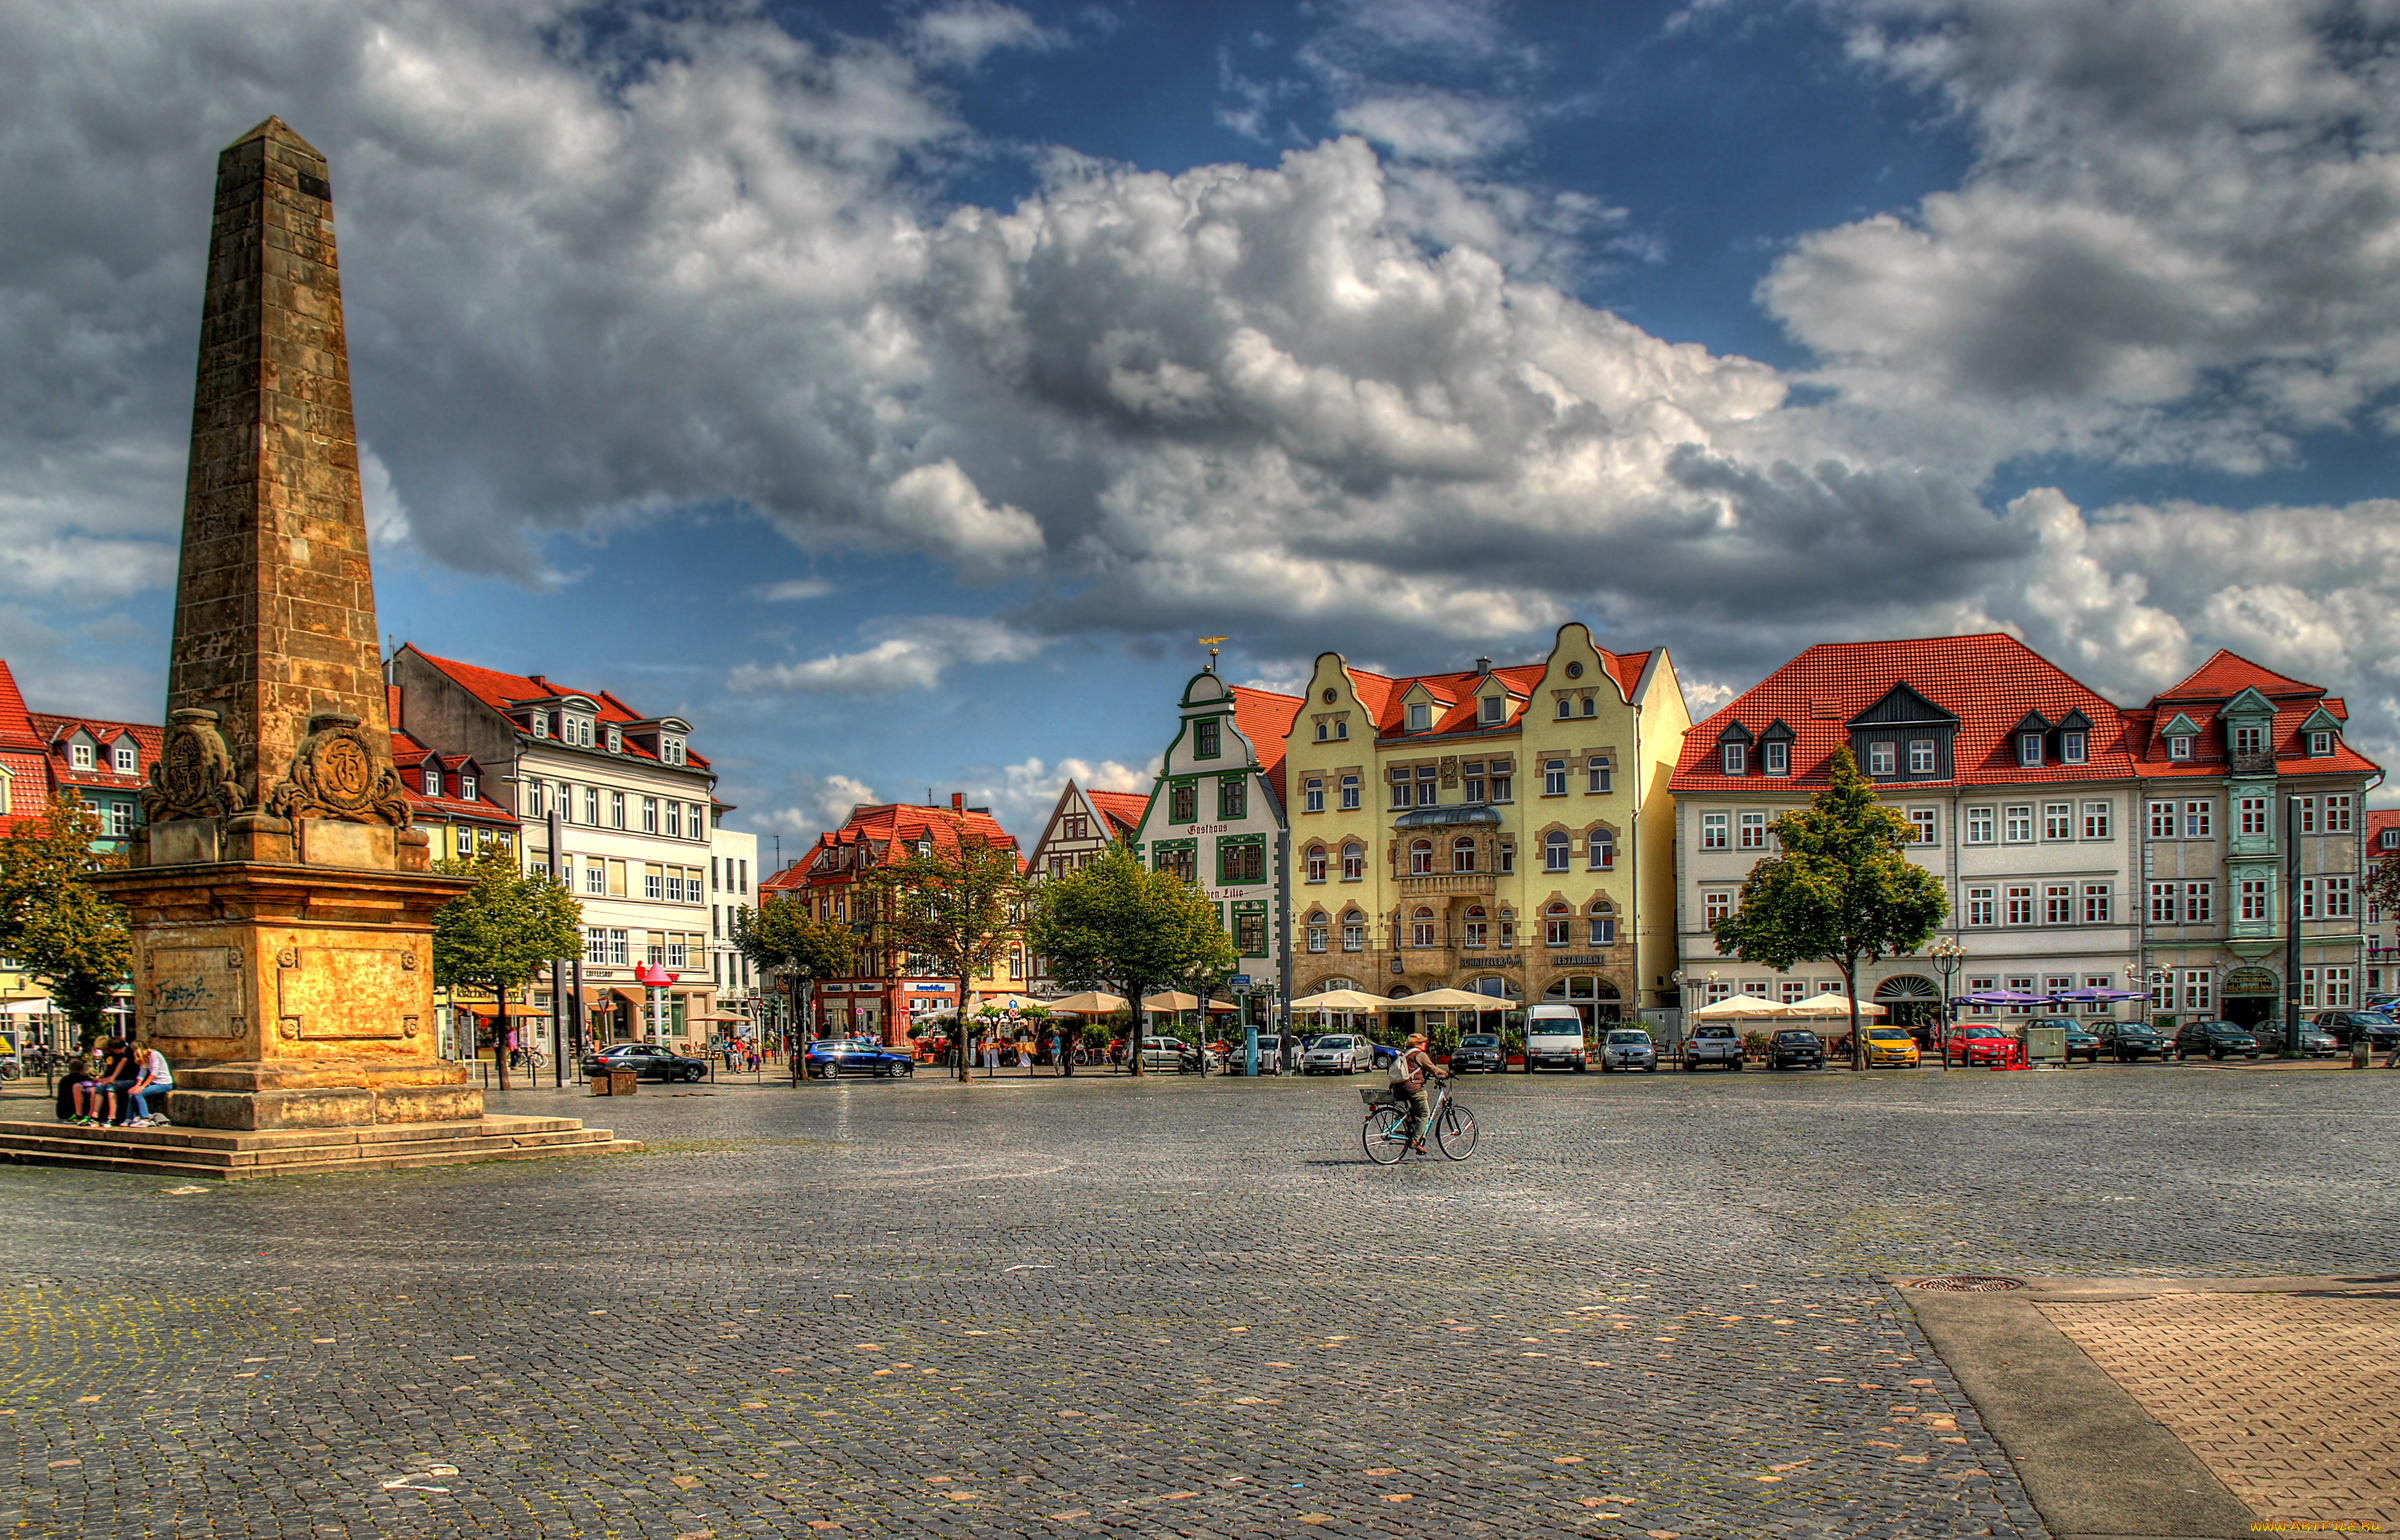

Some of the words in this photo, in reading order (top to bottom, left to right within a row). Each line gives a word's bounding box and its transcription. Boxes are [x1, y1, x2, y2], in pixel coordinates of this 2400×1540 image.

[1187, 823, 1228, 835] Gasthaus
[1460, 957, 1506, 968] SCHNITZLER
[1552, 955, 1605, 966] RESTAURANT
